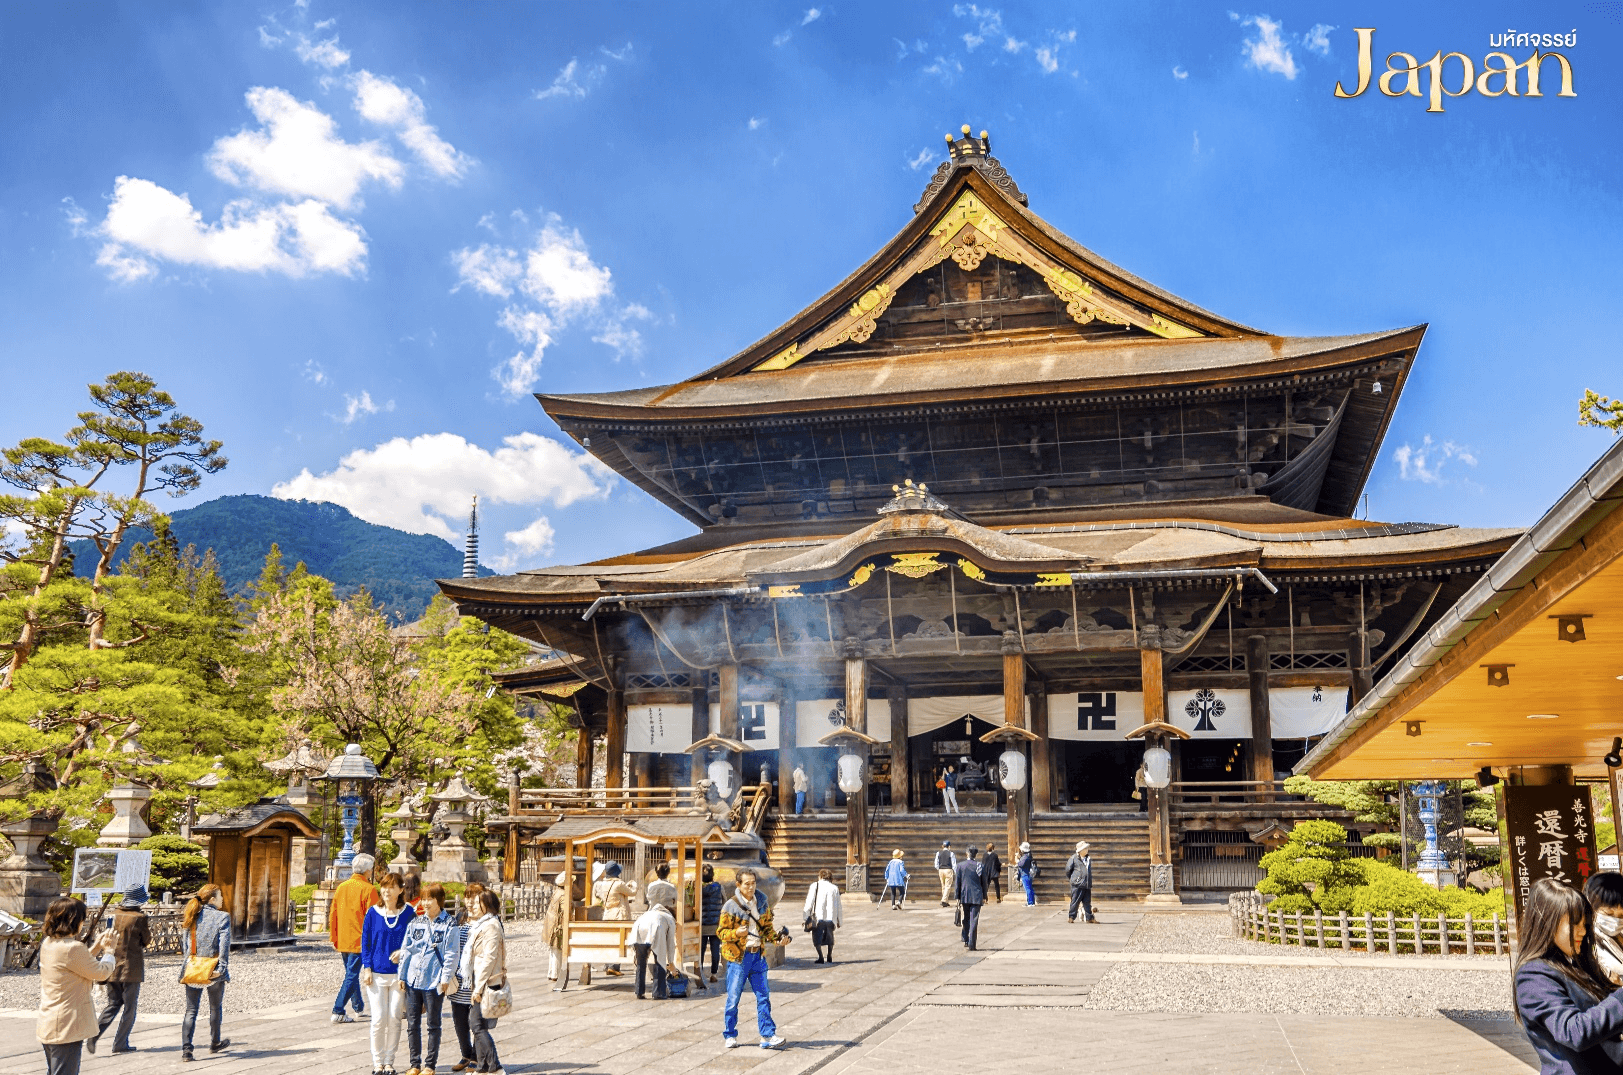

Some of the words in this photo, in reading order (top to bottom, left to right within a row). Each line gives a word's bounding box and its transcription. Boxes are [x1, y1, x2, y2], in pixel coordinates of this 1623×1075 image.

[1571, 798, 1588, 844] 善光寺
[1514, 835, 1530, 912] 詳しくは窓口に
